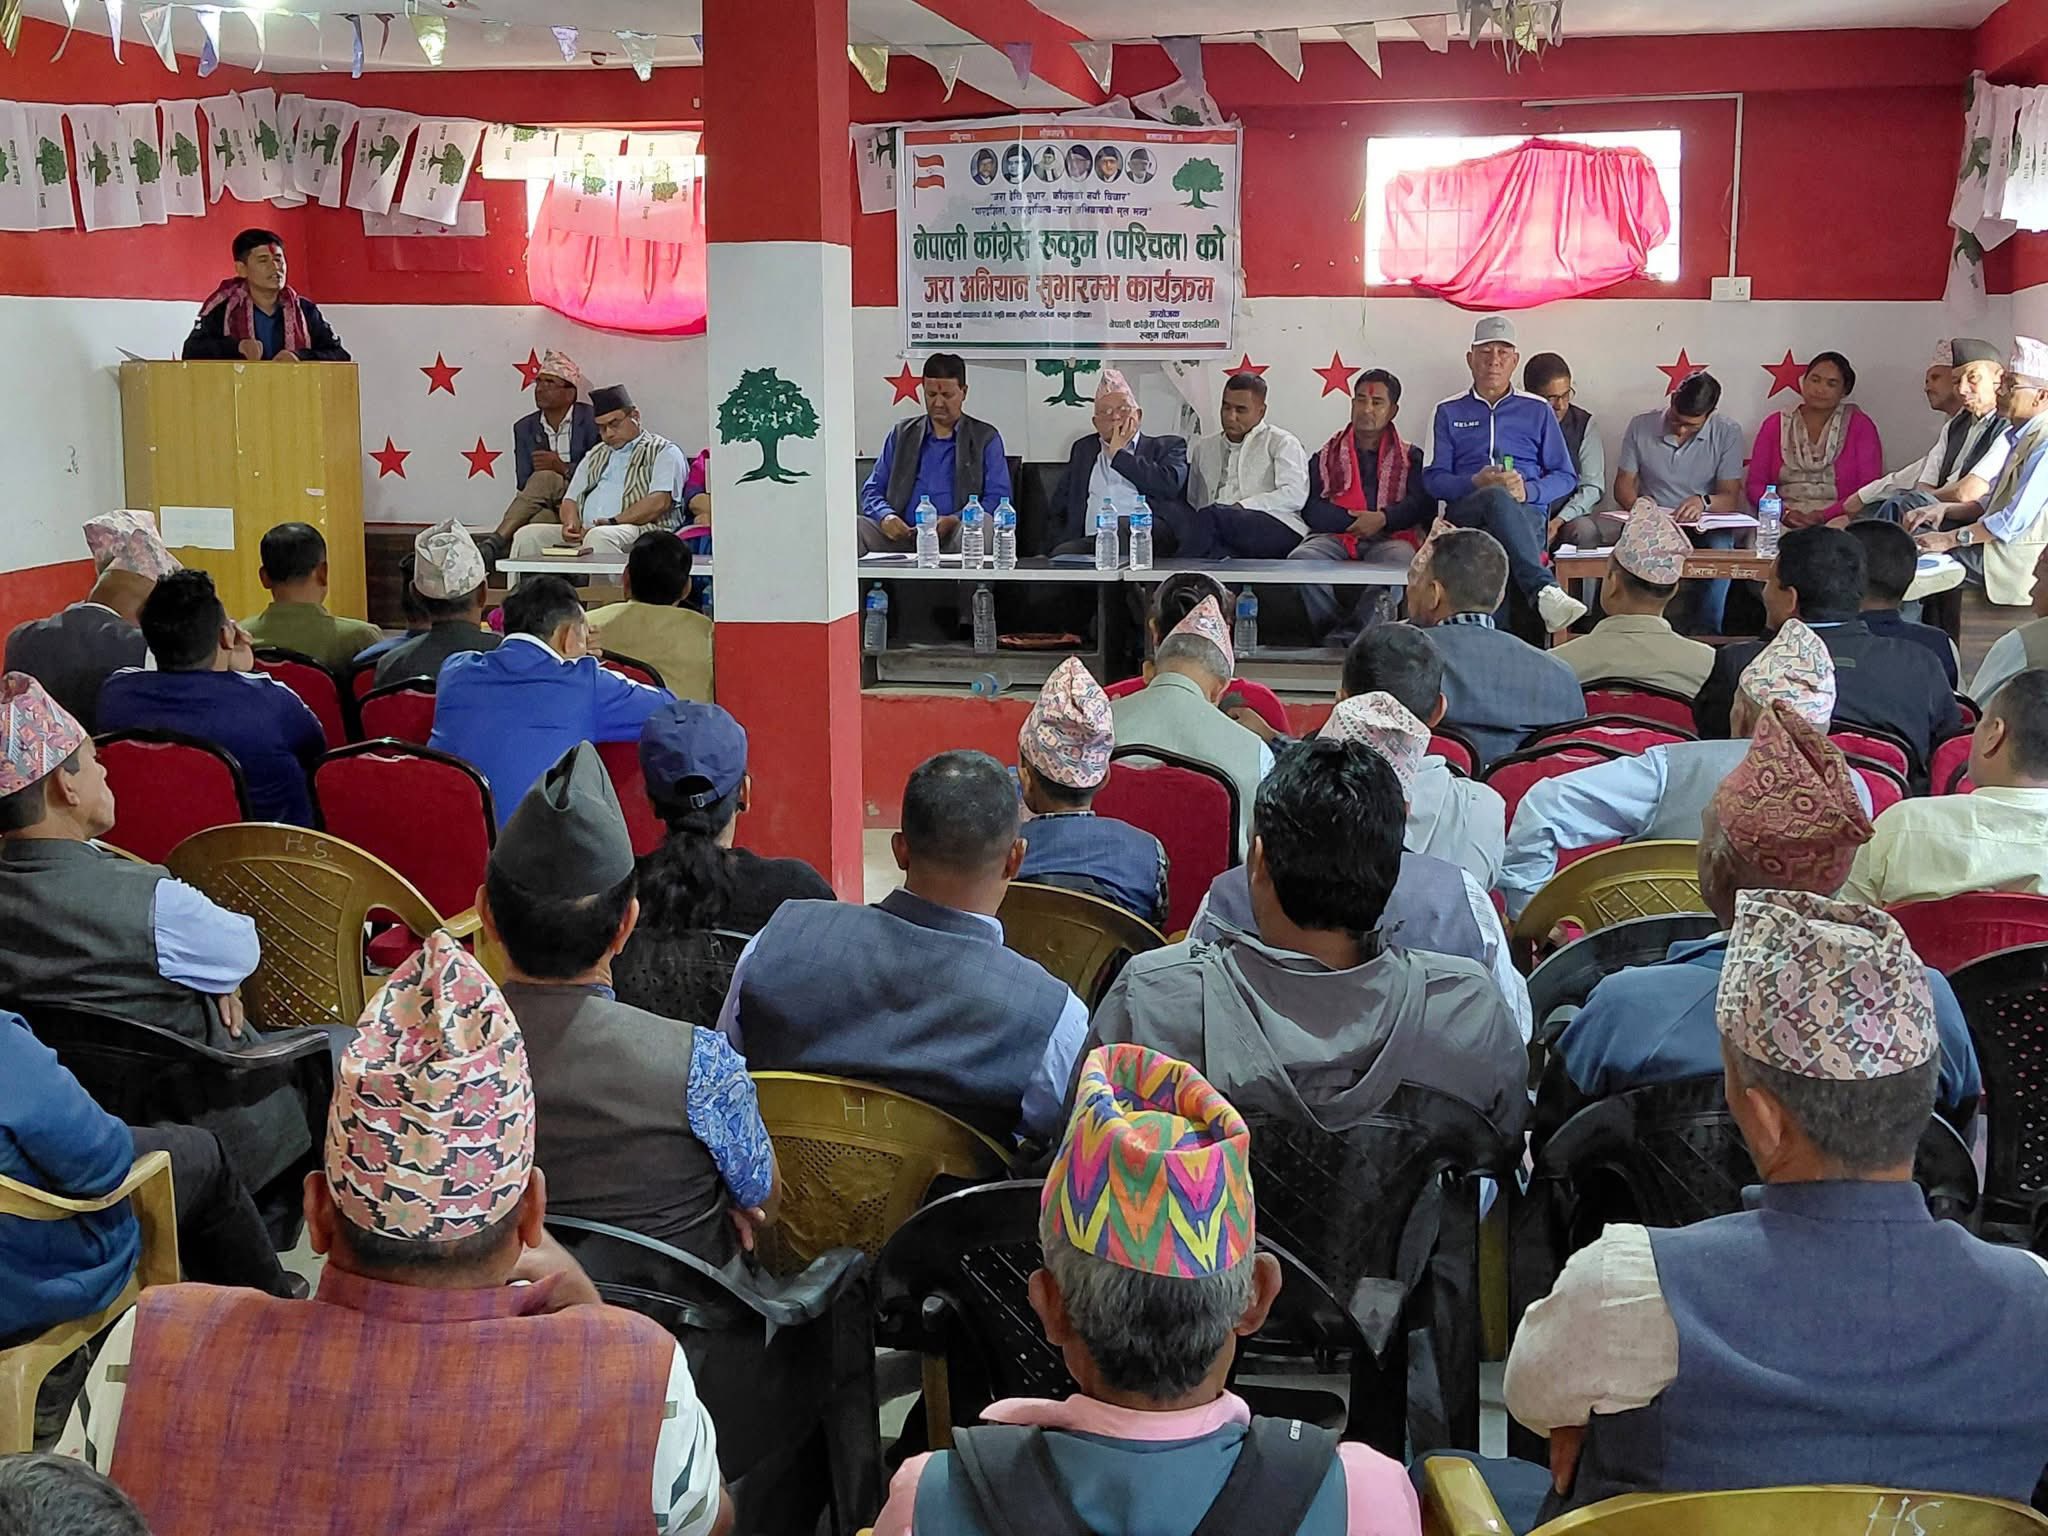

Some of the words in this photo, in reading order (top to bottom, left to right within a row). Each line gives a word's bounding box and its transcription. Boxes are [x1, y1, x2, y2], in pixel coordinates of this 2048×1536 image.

[912, 223, 968, 263] नेपाली
[1107, 221, 1187, 264] (पश्चिम)
[1195, 223, 1227, 262] को
[923, 275, 955, 304] जरा
[959, 266, 1030, 302] अभियान
[1126, 267, 1216, 304] कार्यक्रम
